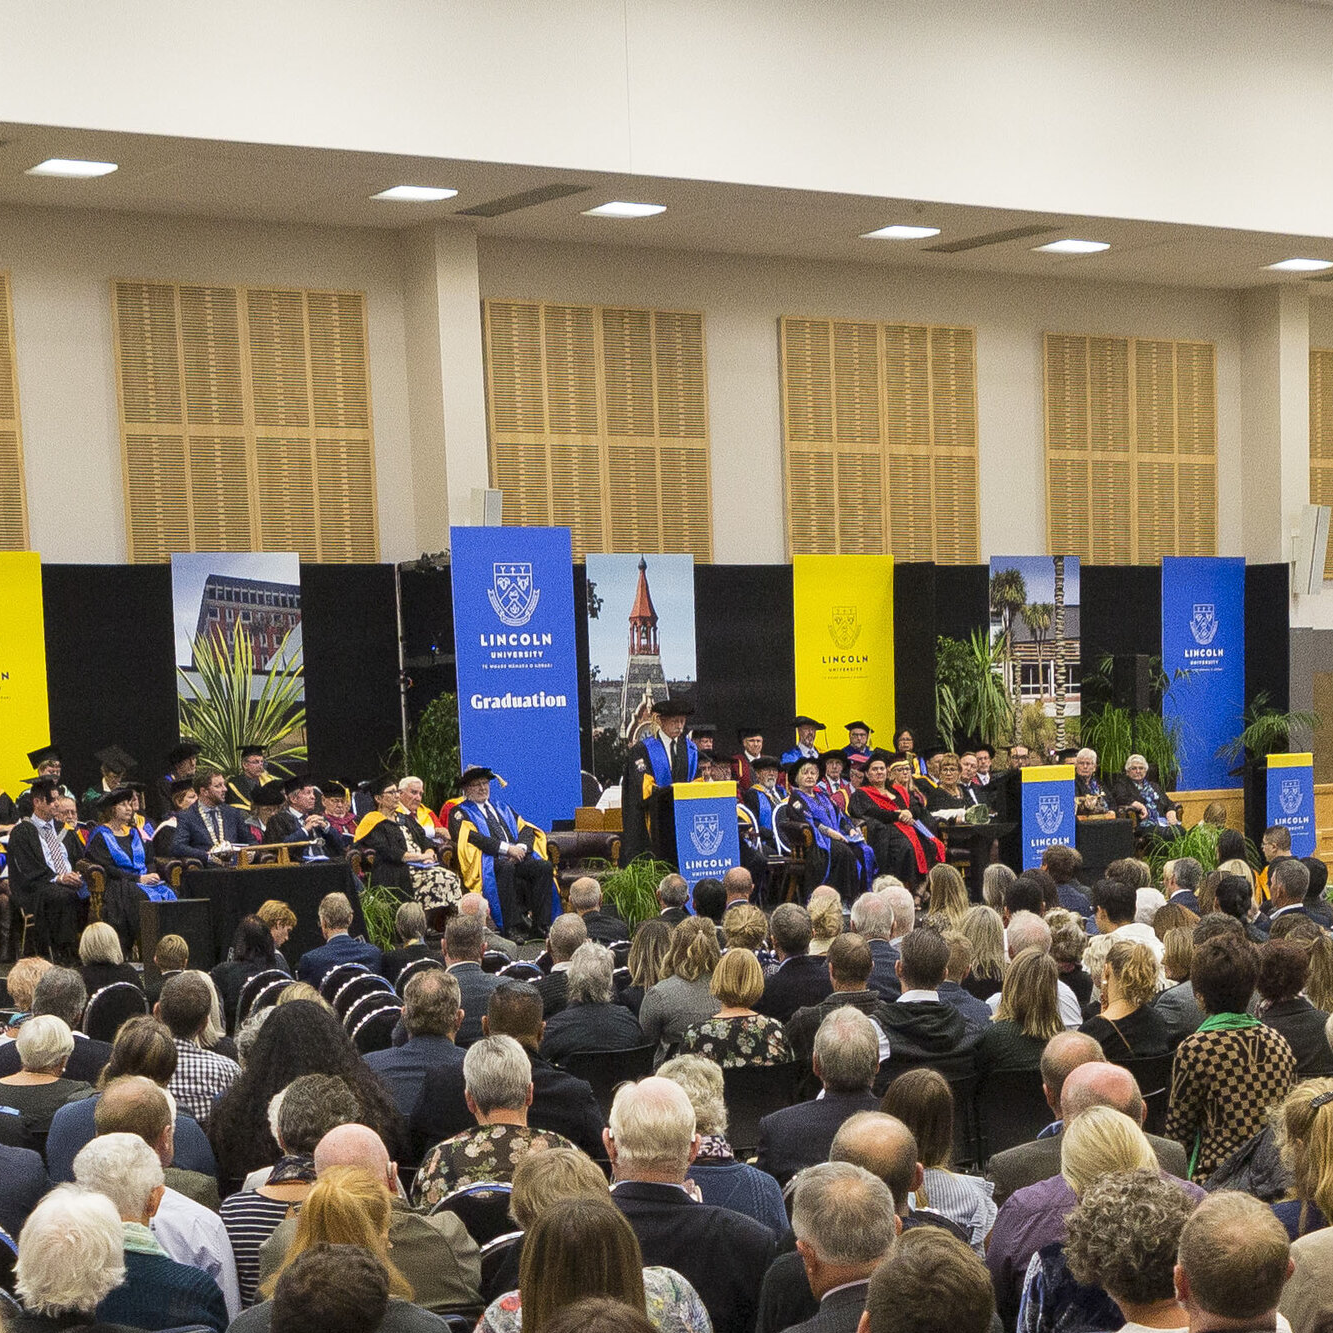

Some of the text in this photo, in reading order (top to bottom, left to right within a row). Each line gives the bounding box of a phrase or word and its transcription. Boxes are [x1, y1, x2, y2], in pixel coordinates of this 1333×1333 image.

[480, 633, 552, 647] LINCOLN
[490, 650, 544, 659] UNIVERSITY
[1184, 648, 1224, 658] LINCOLN
[822, 655, 868, 664] LINCOLN
[470, 691, 567, 710] Graduation
[1275, 816, 1309, 825] LINCOLN
[1030, 836, 1070, 847] LINCOLN
[685, 858, 732, 870] LINCOLN
